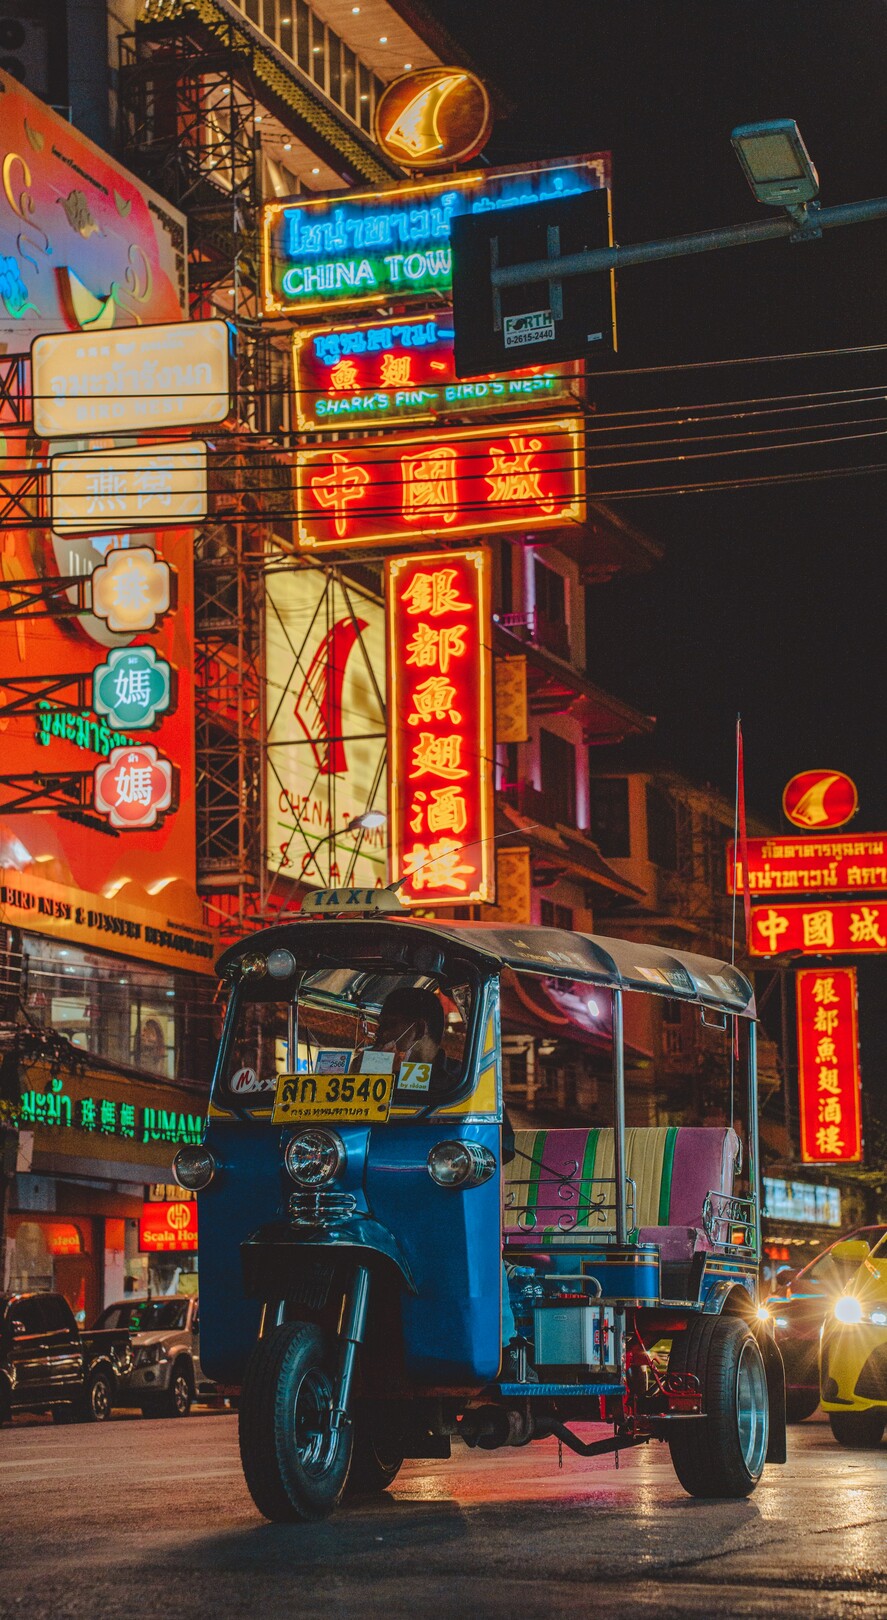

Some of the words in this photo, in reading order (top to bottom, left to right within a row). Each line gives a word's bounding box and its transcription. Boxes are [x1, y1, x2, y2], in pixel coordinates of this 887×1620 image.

[283, 191, 456, 256] ไชน่าทาวน์
[282, 260, 375, 295] CHINA
[506, 329, 553, 346] 0-2615-2440
[76, 403, 125, 421] BIRD
[135, 397, 186, 416] NEST
[315, 393, 390, 416] SHARK'S
[445, 379, 505, 402] BIRD'S
[509, 372, 556, 393] NEST
[311, 432, 555, 537] 中國城
[113, 668, 152, 708] 媽
[401, 568, 477, 891] 銀都魚翅酒樓
[114, 766, 153, 807] 媽
[278, 788, 333, 831] CHINA
[1, 886, 36, 910] BIRD
[314, 889, 375, 906] TAXI
[756, 906, 887, 952] 中國城
[401, 1062, 431, 1083] 73
[811, 977, 846, 1157] 銀都魚翅酒樓
[325, 1077, 387, 1103] 3540
[143, 1230, 175, 1243] Scala
